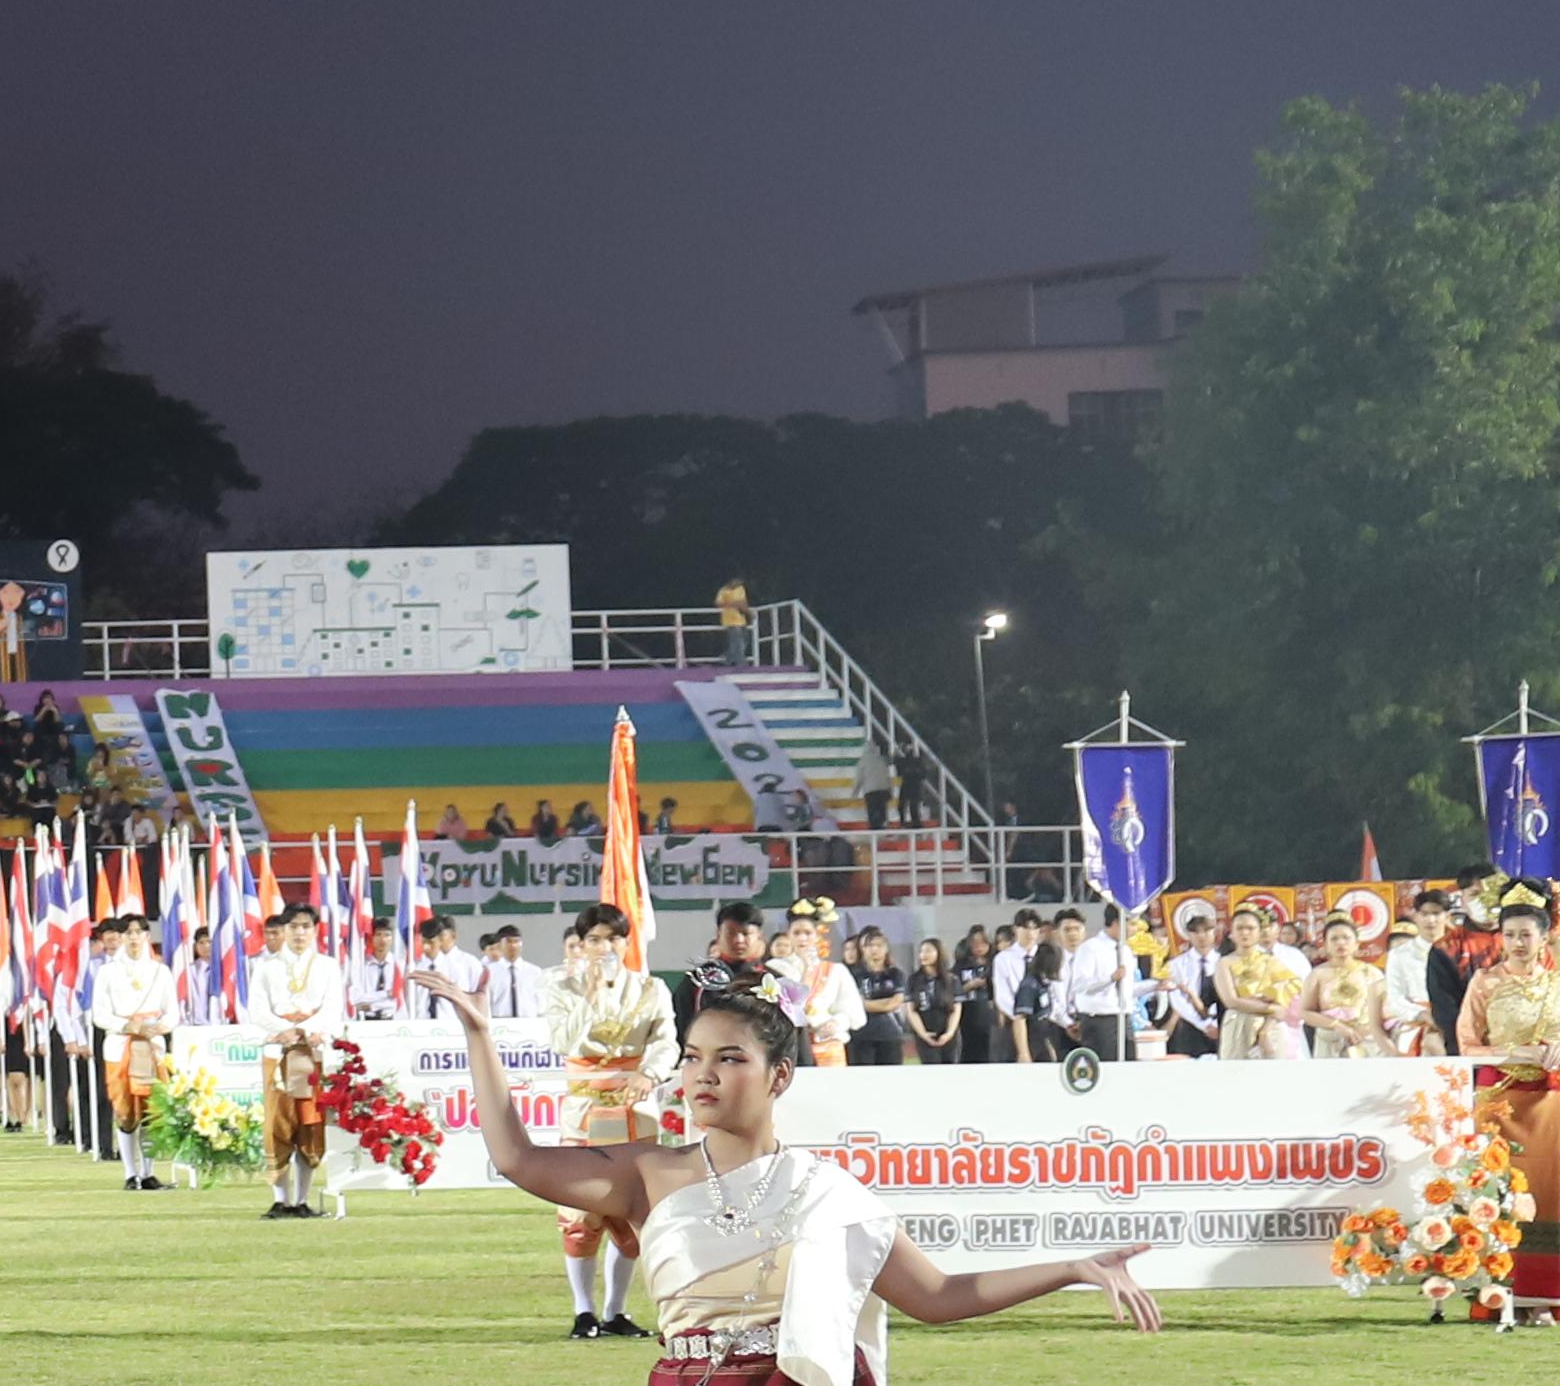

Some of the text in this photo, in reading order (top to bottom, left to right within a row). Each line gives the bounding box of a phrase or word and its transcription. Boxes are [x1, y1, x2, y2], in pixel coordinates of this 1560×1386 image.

[809, 1127, 1381, 1195] าวิทยาลัยราชภัฏกำแพงเพชร
[905, 1211, 1347, 1244] ENG PHET RAJABHAT UNIVERSITY
